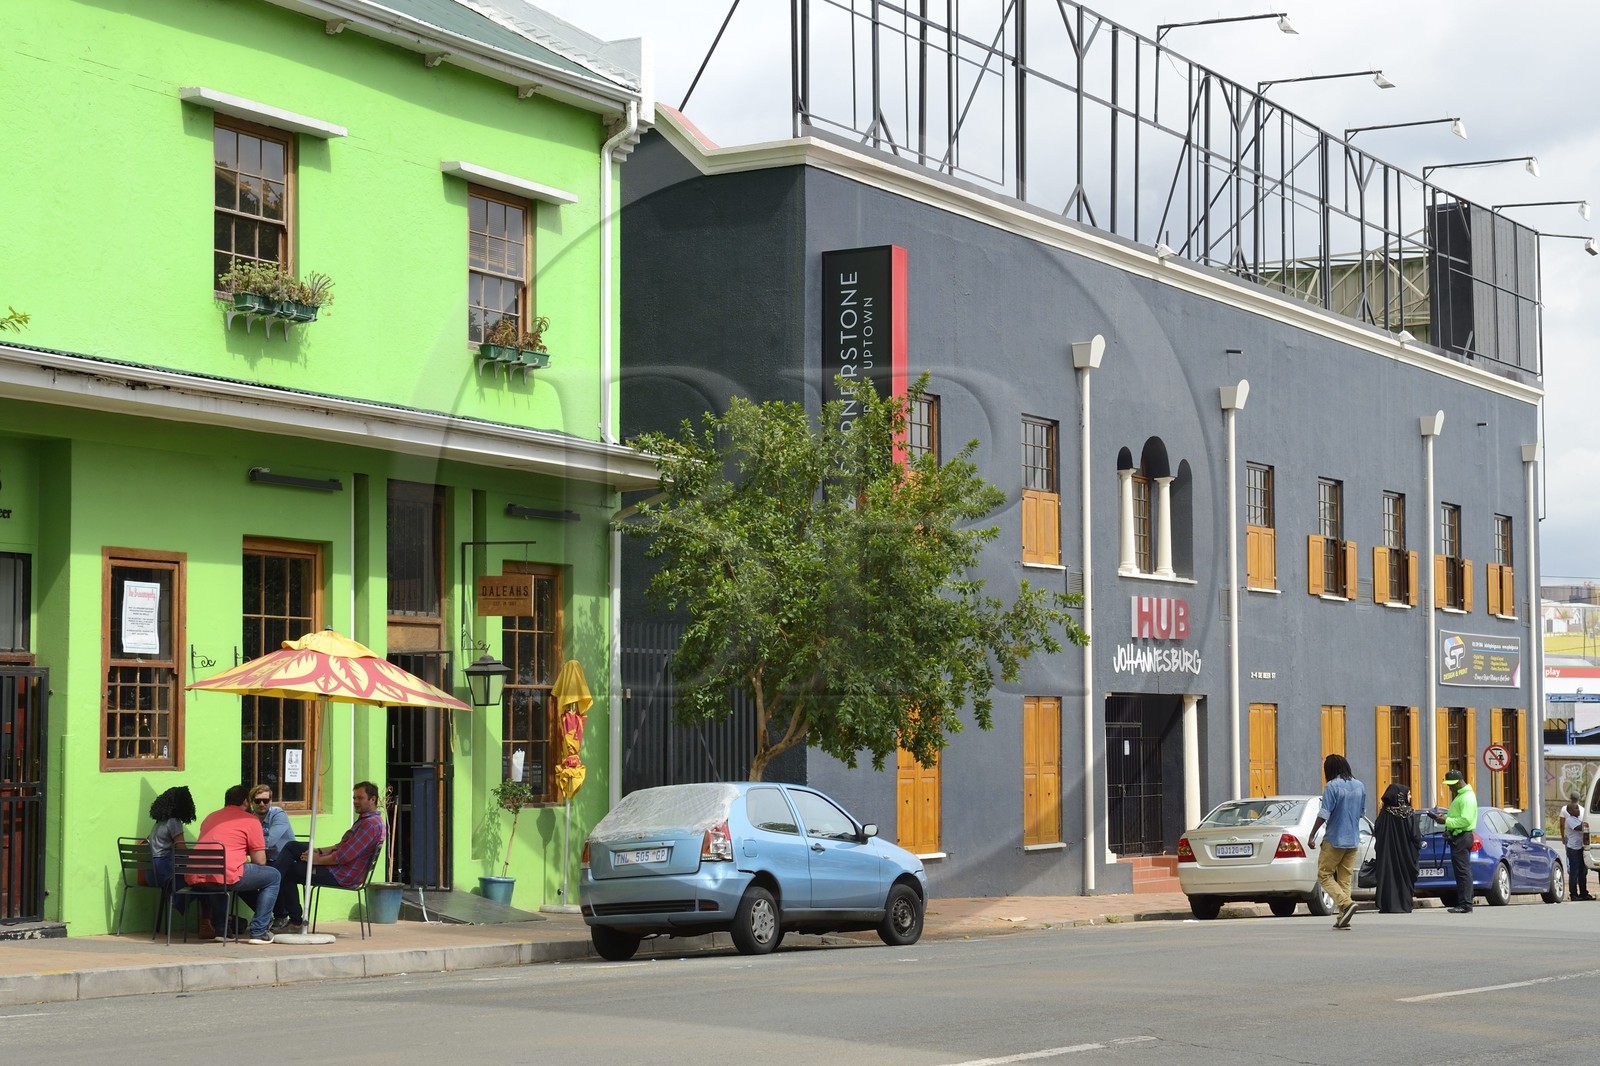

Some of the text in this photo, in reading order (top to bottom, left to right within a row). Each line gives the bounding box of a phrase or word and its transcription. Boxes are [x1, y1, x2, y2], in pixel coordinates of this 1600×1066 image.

[863, 297, 874, 370] UPTOWN
[840, 271, 858, 476] RNERSTONE
[482, 585, 529, 597] DALEAHS
[1132, 595, 1190, 640] HUB
[1113, 643, 1202, 675] JOHANNESBURG
[1545, 667, 1561, 678] play
[656, 850, 665, 860] GP
